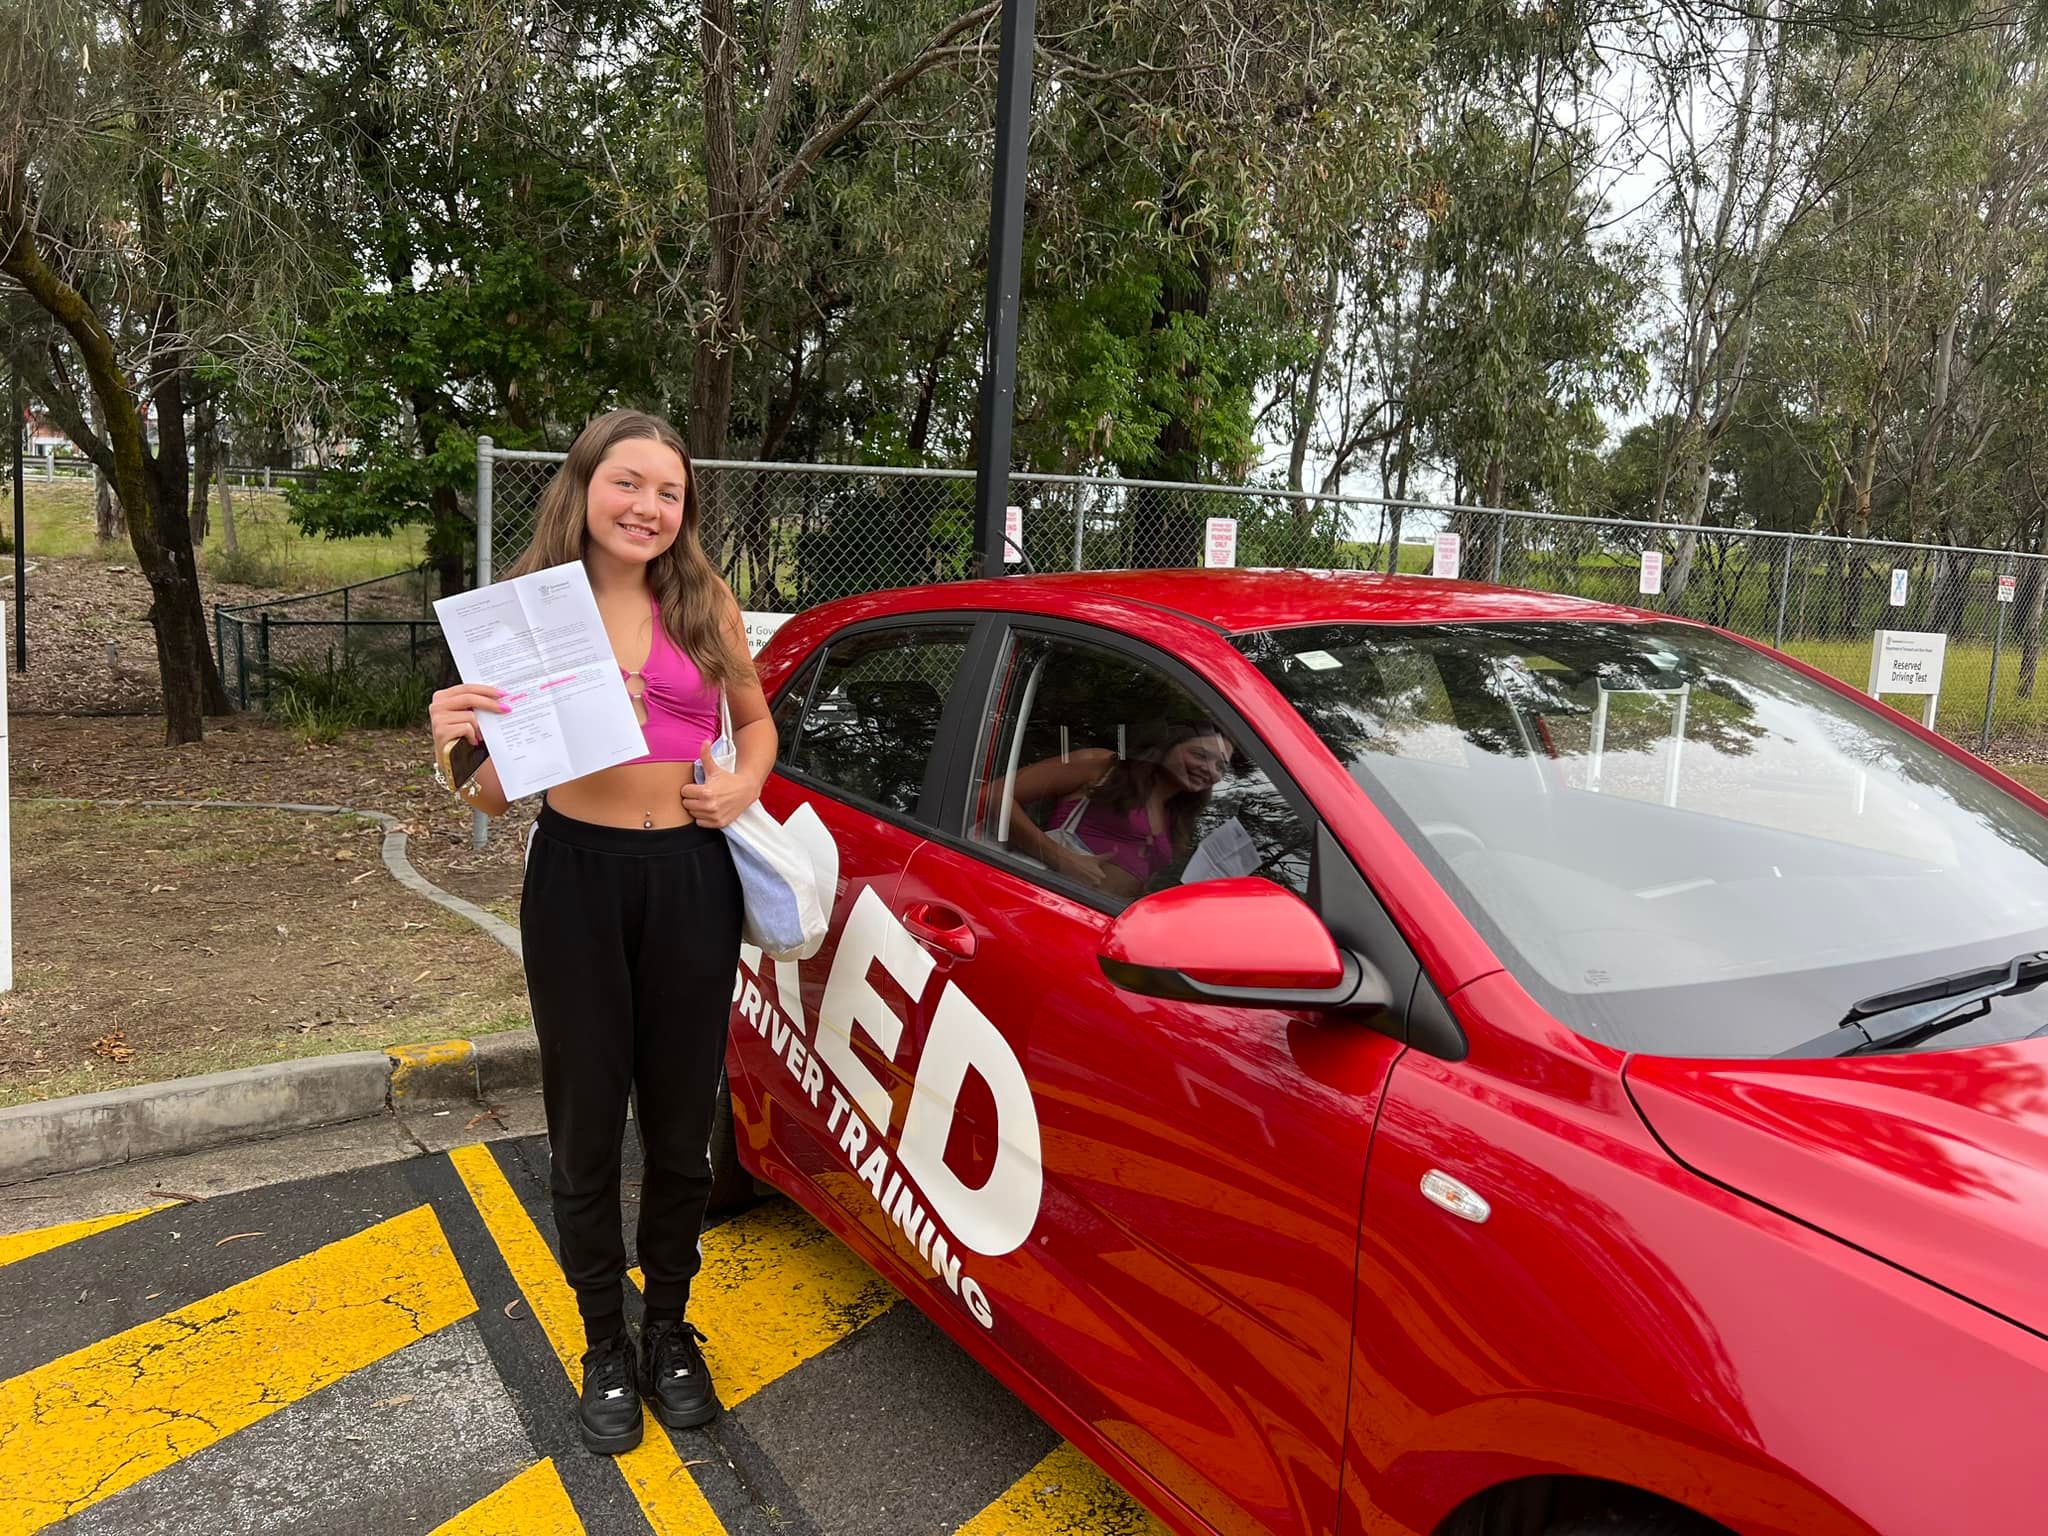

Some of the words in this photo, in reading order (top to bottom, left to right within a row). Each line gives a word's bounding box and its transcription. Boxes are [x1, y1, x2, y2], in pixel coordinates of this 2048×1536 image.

[756, 625, 776, 635] Gov
[1893, 659, 1922, 671] Reserved
[1891, 671, 1914, 684] Driving
[1915, 672, 1928, 683] Test
[827, 1084, 994, 1330] TRAINING
